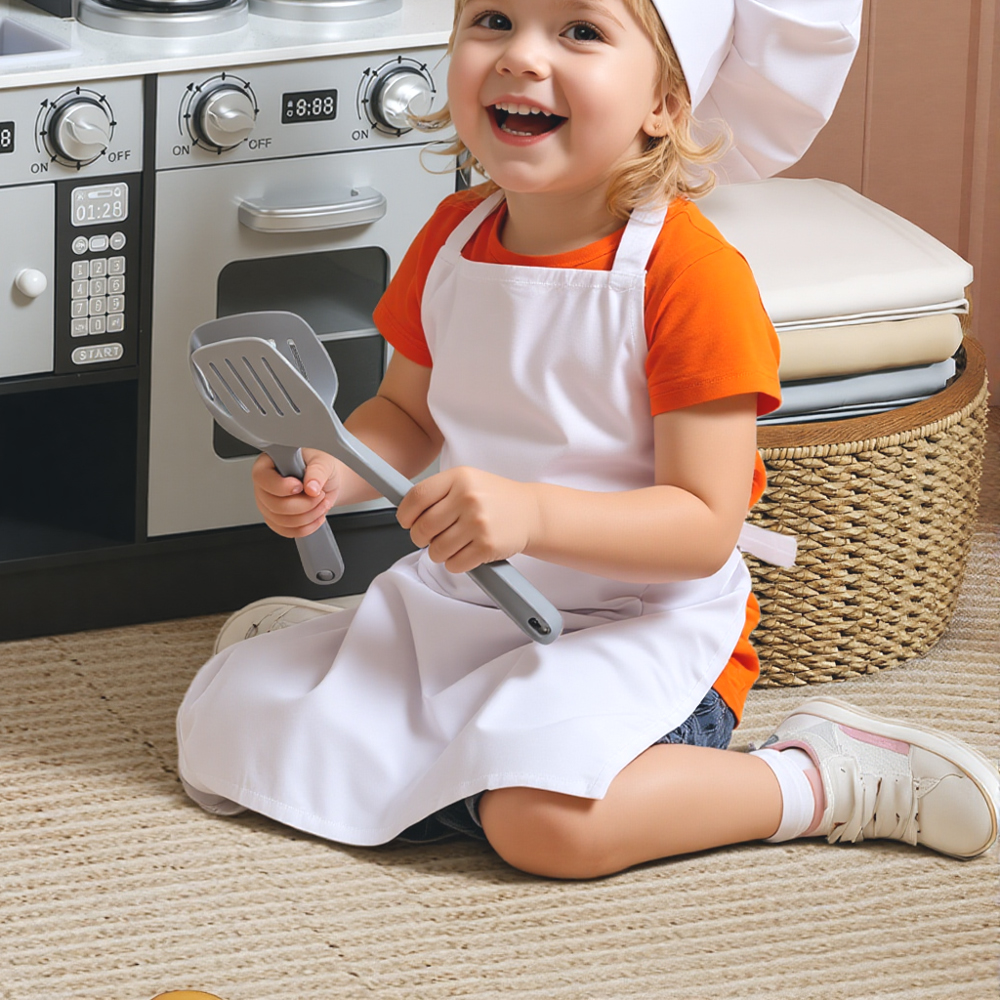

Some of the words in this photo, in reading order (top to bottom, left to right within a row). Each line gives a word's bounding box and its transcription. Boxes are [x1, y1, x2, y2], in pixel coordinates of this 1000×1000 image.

[351, 129, 369, 141] ON
[172, 145, 190, 156] ON
[248, 138, 272, 150] OFF
[108, 150, 131, 163] OFF
[30, 162, 49, 175] ON
[76, 200, 122, 221] 01:28
[79, 346, 119, 361] START
